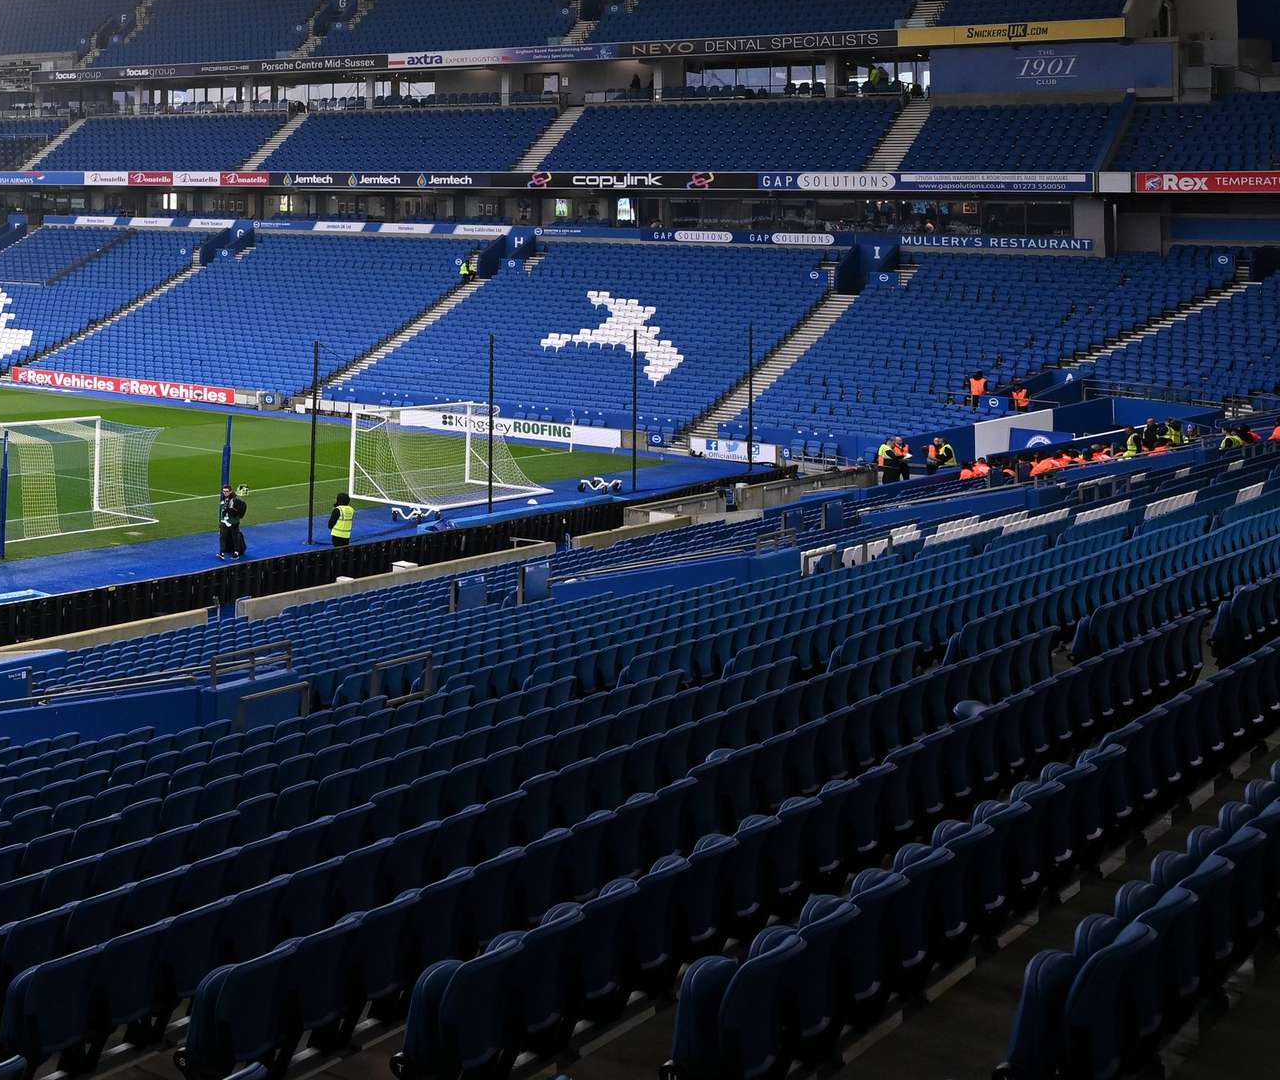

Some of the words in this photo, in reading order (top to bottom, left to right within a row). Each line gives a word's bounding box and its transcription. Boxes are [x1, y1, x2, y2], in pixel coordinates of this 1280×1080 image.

[632, 42, 695, 55] NEYO
[704, 39, 766, 53] DENTAL
[770, 33, 879, 50] SPECIALISTS
[261, 62, 293, 71] Porsche
[295, 61, 323, 69] Centre
[324, 58, 375, 68] Mid-Sussex
[407, 54, 442, 65] axtra
[1019, 57, 1076, 76] 1901
[92, 173, 126, 183] Donatello
[131, 173, 171, 183] Donatello
[177, 173, 218, 184] Donatello
[223, 173, 267, 184] Donatello
[294, 175, 332, 184] Jemtech
[359, 175, 400, 184] Jemtech
[428, 175, 472, 185] Jemtech
[573, 173, 662, 188] copylink
[763, 175, 793, 187] GAP
[803, 175, 890, 187] SOLUTIONS
[1163, 175, 1208, 190] Rex
[918, 183, 1005, 191] www.gapsolutions.co.uk
[653, 231, 672, 239] GAP
[677, 232, 730, 242] SOLUTIONS
[750, 234, 769, 242] GAP
[775, 234, 831, 244] SOLUTIONS
[514, 237, 524, 248] H
[902, 237, 983, 247] MULLERY'S
[991, 238, 1092, 250] RESTAURANT
[27, 371, 52, 384] Rex
[54, 374, 114, 391] Vehicles
[130, 381, 157, 395] Rex
[159, 384, 227, 403] Vehicles
[514, 421, 571, 438] ROOFING
